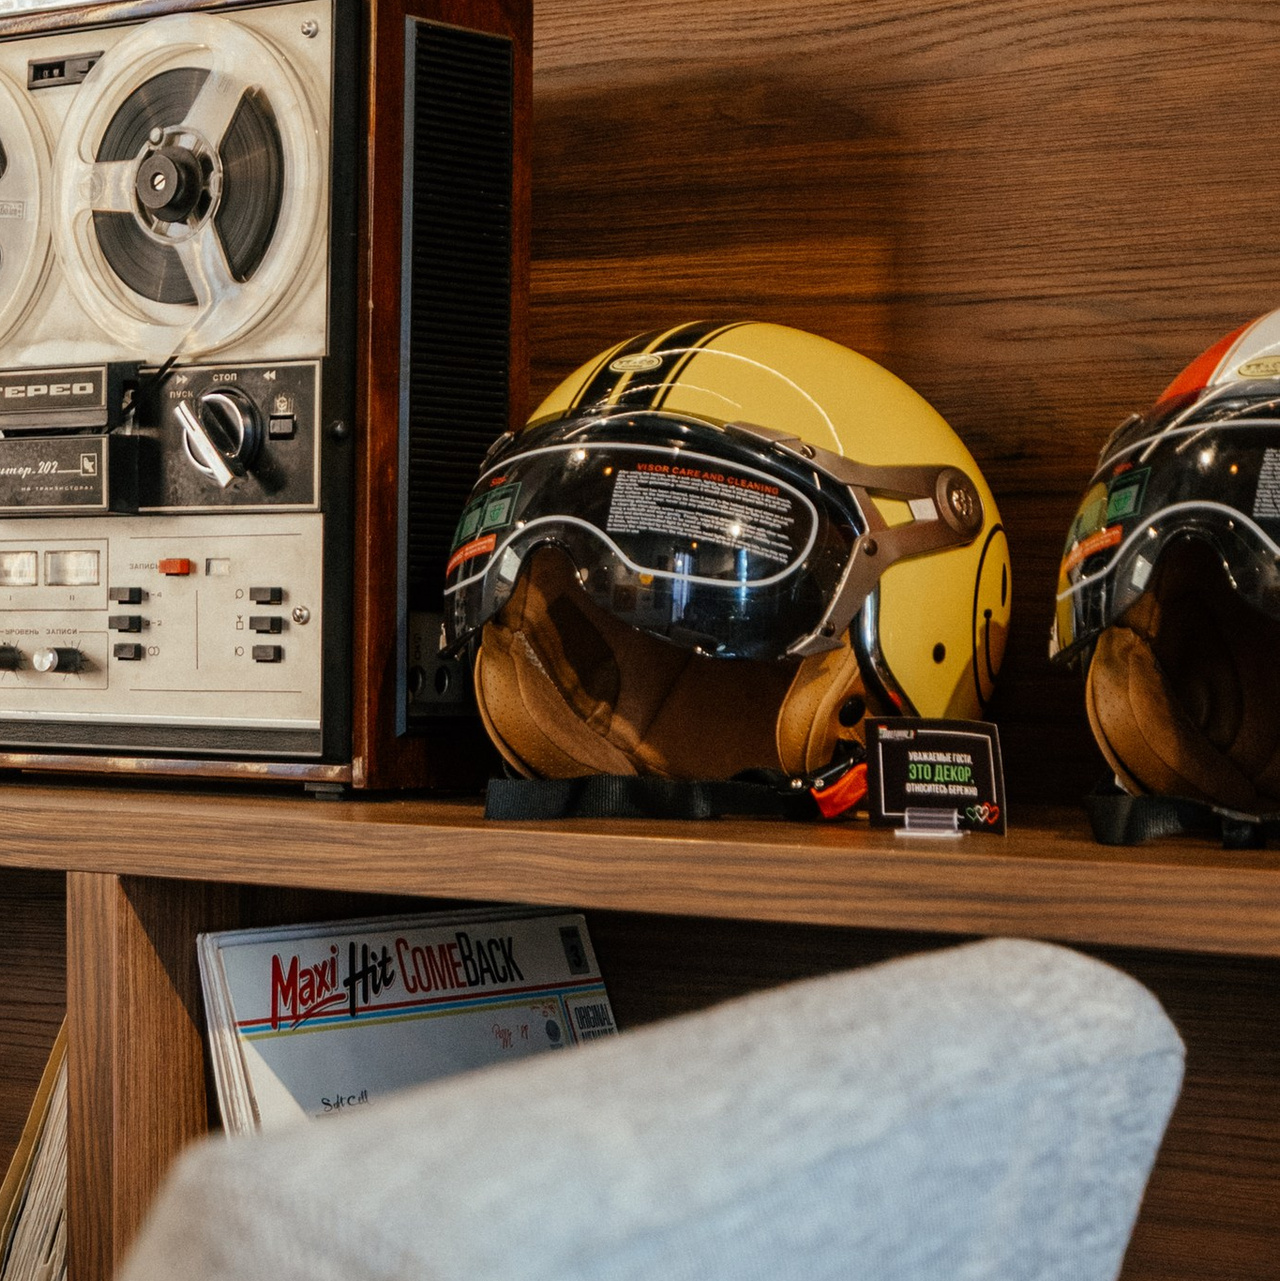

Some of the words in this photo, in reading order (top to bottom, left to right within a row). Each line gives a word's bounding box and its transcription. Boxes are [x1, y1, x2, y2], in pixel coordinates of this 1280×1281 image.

[212, 372, 238, 382] СТОП
[169, 390, 194, 399] ПУСК
[637, 462, 670, 474] VISOR
[672, 466, 701, 479] CARE
[702, 472, 725, 483] AND
[727, 475, 781, 496] CLEANING
[5, 627, 40, 636] УРОВЕНЬ
[46, 627, 78, 636] ЗАПИСИ
[908, 751, 952, 763] УВАЖАЕМЫЕ
[908, 763, 932, 780] ЭТО
[934, 764, 975, 784] ДЕКОР,
[905, 782, 948, 794] ОТНОСИТЕСЬ
[948, 784, 978, 797] БЕРЕЖНО
[271, 944, 342, 1031] Maxi
[344, 941, 396, 1017] Hit
[574, 1003, 614, 1030] ORIGINAL
